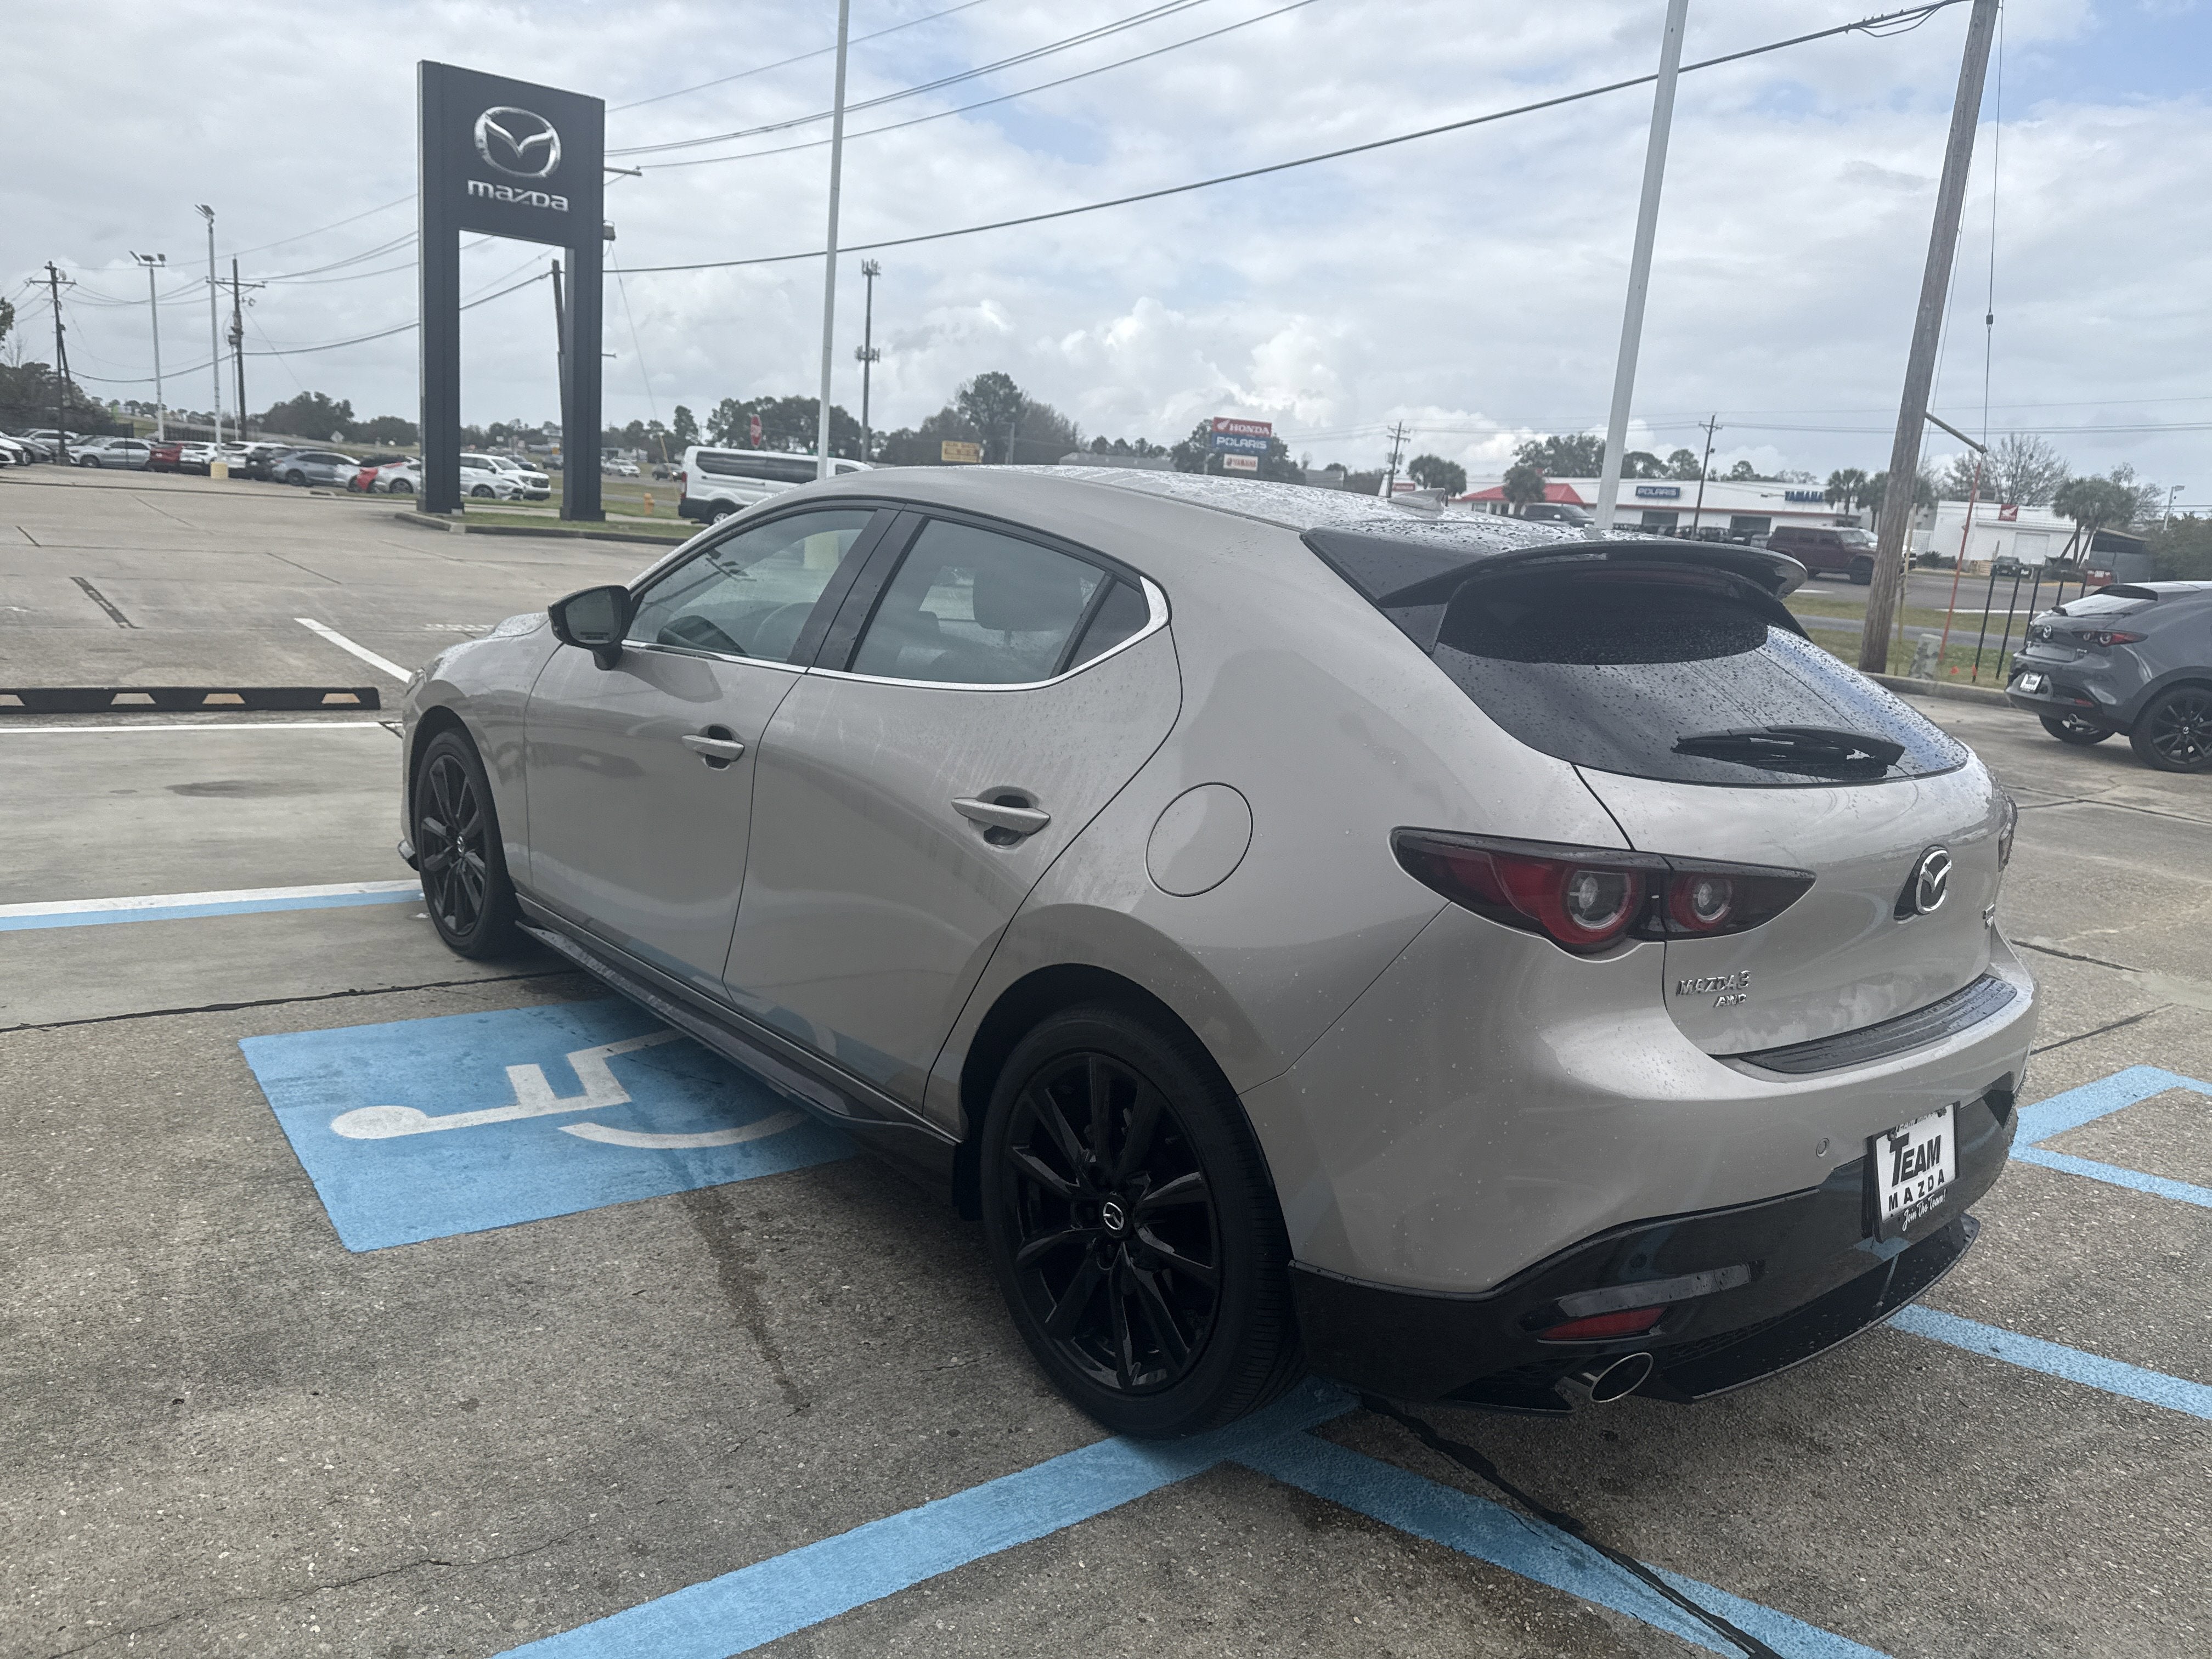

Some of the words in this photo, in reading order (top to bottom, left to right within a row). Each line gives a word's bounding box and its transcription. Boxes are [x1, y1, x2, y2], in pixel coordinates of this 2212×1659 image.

[1229, 423, 1270, 435] HONDA
[1216, 436, 1267, 449] POLARIS
[1713, 994, 1747, 1008] AWD
[1888, 1169, 1944, 1212] MAZDA
[1902, 1209, 1917, 1232] Join
[1916, 1200, 1928, 1217] The
